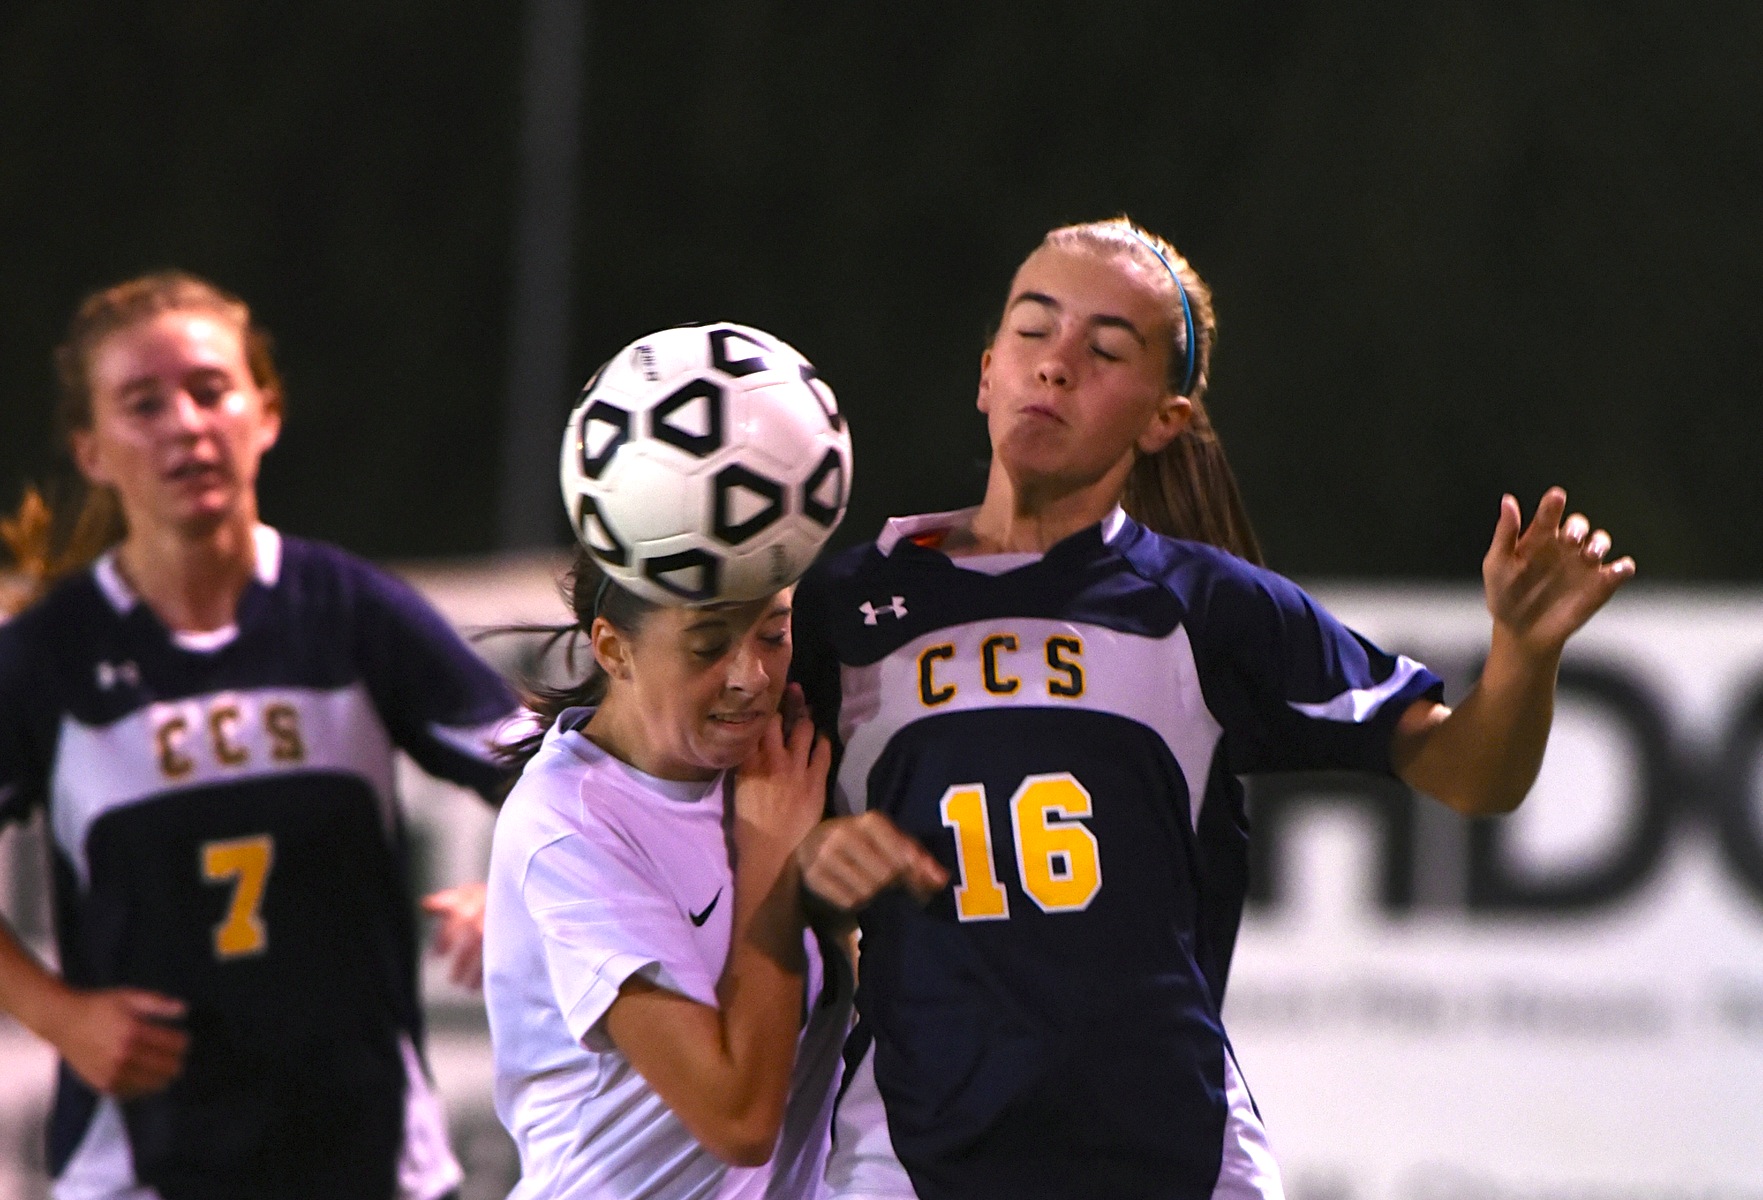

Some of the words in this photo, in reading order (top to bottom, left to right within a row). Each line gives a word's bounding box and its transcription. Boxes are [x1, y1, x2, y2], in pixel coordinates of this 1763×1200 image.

[917, 633, 1085, 706] CCS
[155, 702, 305, 780] CCS
[202, 833, 274, 958] 7
[940, 771, 1102, 922] 16
